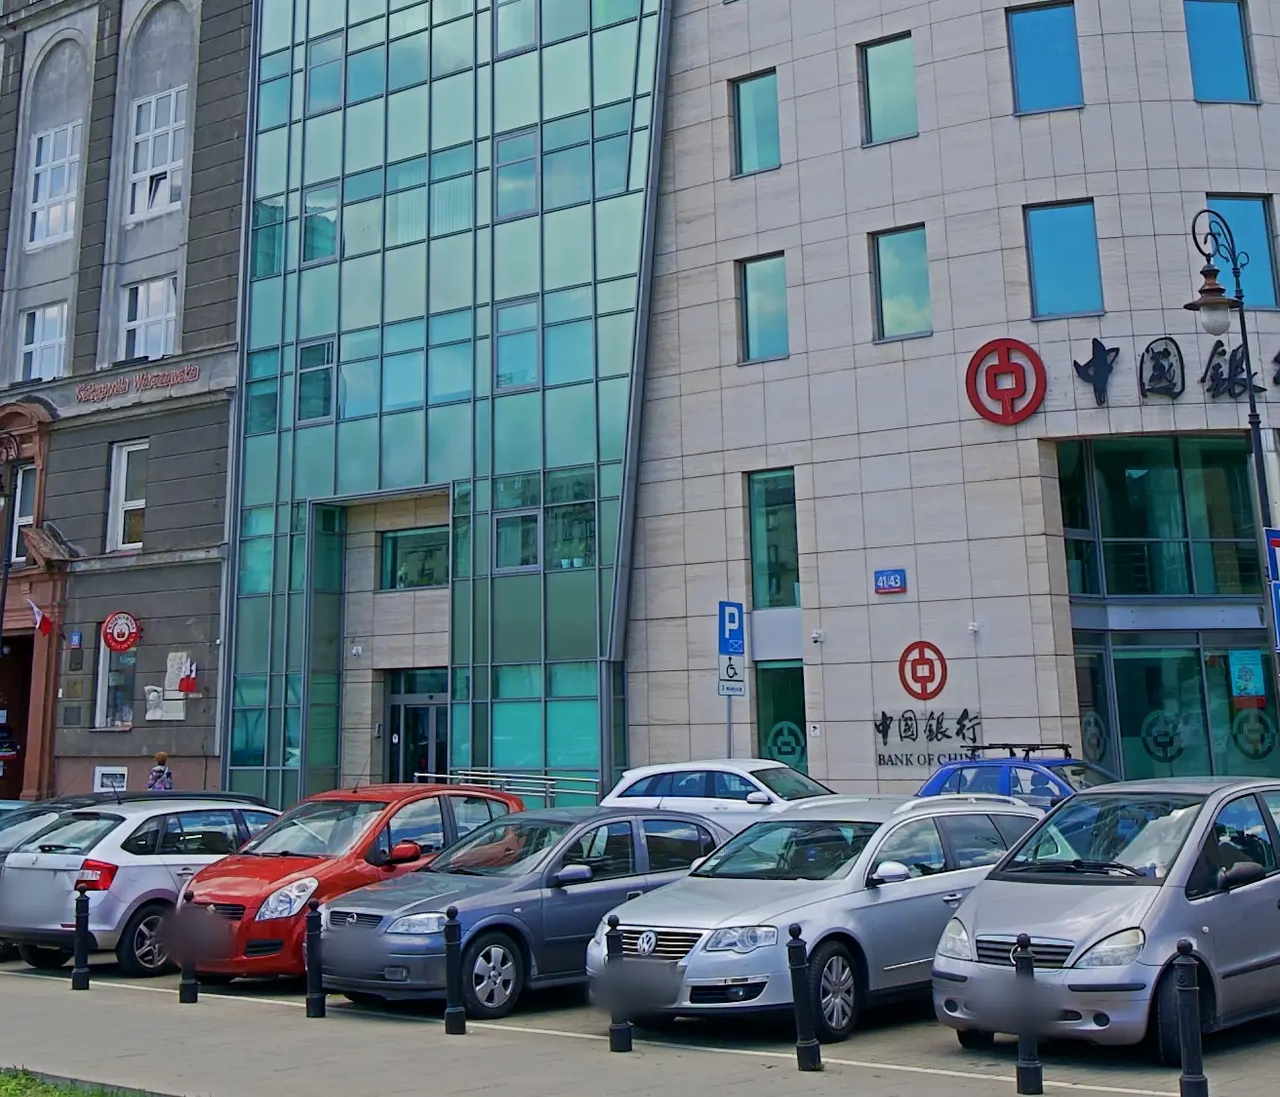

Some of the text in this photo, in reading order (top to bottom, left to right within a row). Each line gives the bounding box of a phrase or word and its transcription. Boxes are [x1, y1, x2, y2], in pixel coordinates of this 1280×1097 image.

[725, 606, 739, 638] P
[878, 753, 913, 766] BANK
[917, 753, 935, 766] OF
